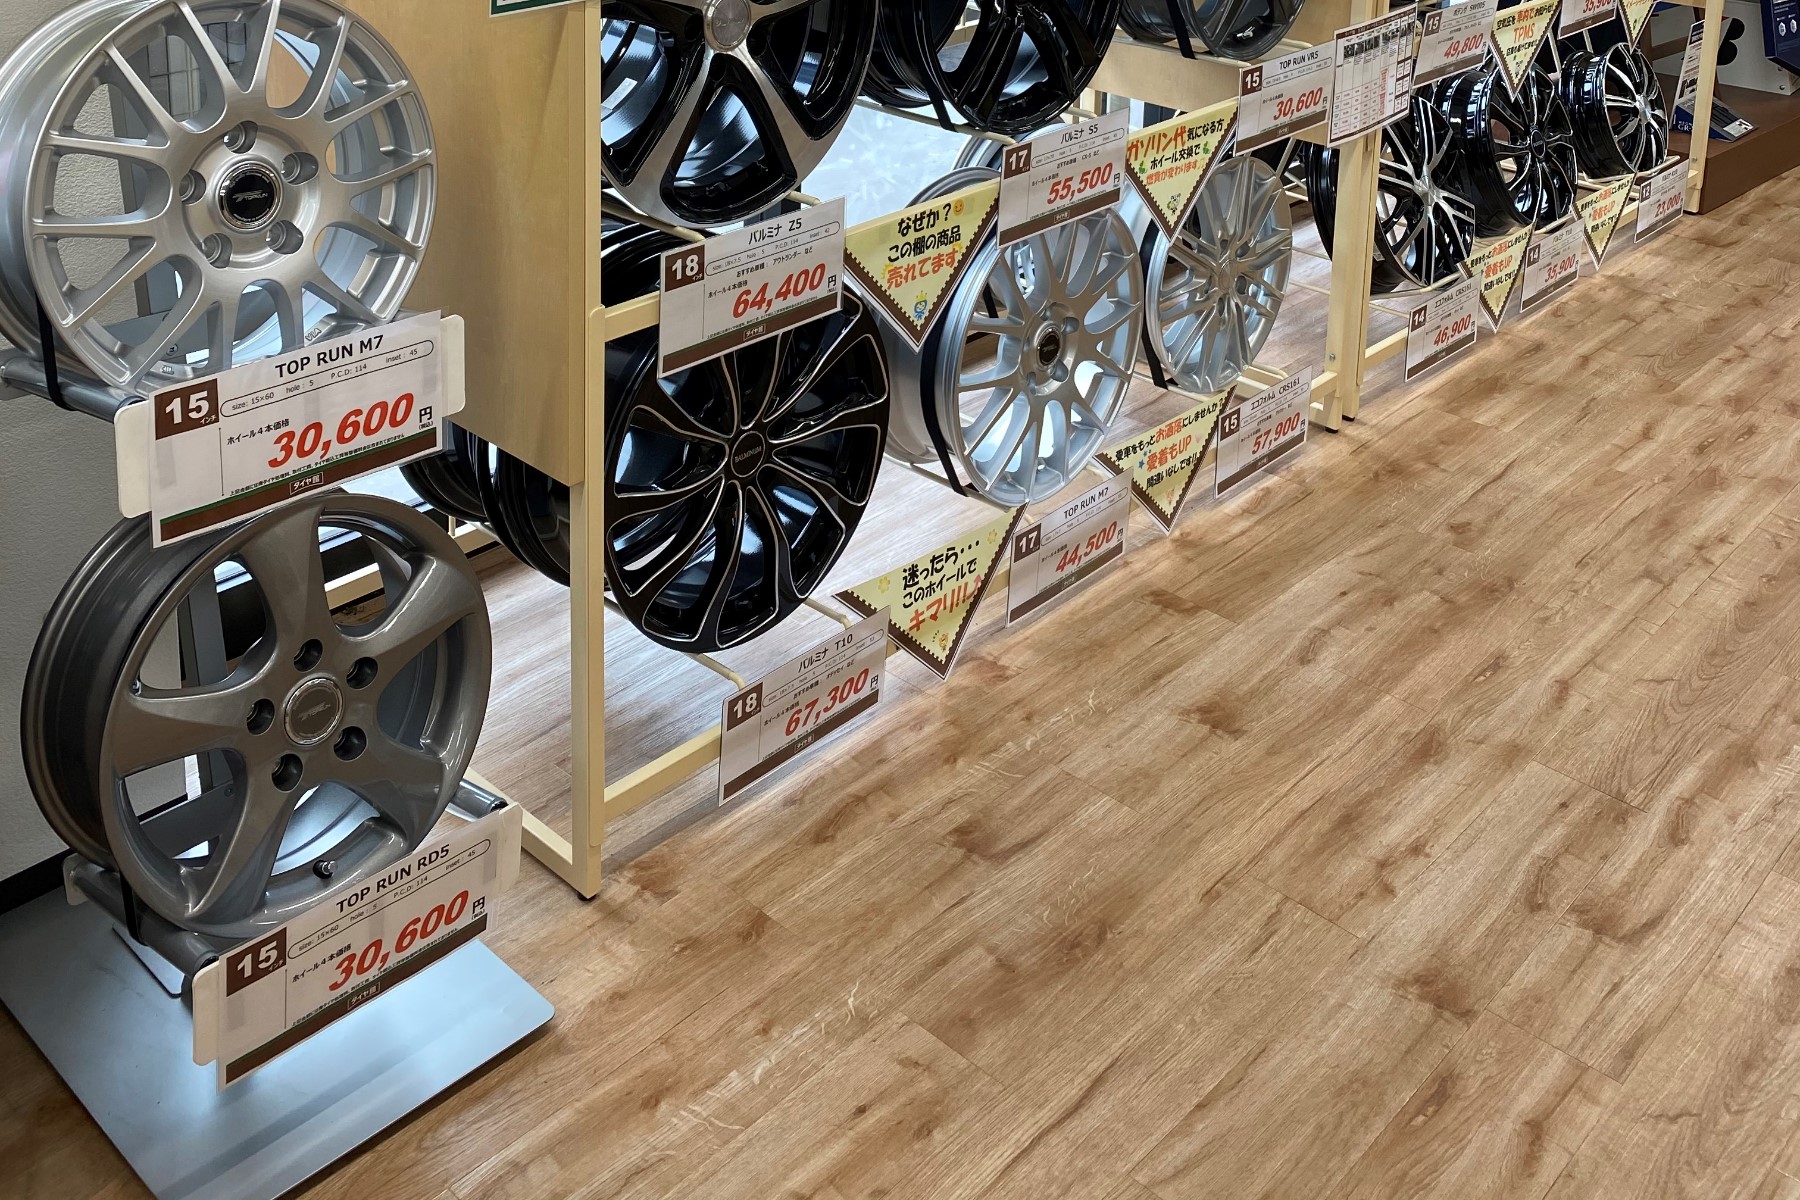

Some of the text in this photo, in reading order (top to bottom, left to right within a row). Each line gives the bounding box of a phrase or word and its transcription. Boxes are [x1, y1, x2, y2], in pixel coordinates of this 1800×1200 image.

[1428, 16, 1439, 31] 15
[1513, 23, 1536, 44] TPMS
[1444, 32, 1484, 59] 49,800
[1245, 71, 1260, 89] 15
[1280, 60, 1291, 70] TOP
[1274, 87, 1323, 120] 30,600
[1060, 123, 1099, 145] バルミナ S5
[1009, 149, 1028, 171] 17
[1150, 143, 1201, 170] ホイール交換で
[1047, 162, 1113, 205] 55,500
[1653, 191, 1682, 219] 23,000
[749, 217, 802, 245] バルミナ Z5
[888, 224, 961, 263] この棚の商品
[671, 254, 699, 280] 18
[886, 248, 959, 290] 売れてます
[1529, 249, 1540, 263] 14
[1544, 253, 1577, 284] 35,900
[732, 263, 837, 319] 64,400 円
[1413, 312, 1425, 327] 14
[1433, 313, 1472, 347] 46,900
[275, 335, 384, 379] TOP RUN M7
[164, 390, 210, 424] 15
[1223, 414, 1238, 433] 15
[267, 392, 433, 469] 30,600 円
[1251, 411, 1301, 455] 57,900
[1019, 487, 1109, 553] 17 TOP RUN M7
[1055, 520, 1118, 573] 44,500
[902, 557, 977, 609] このホイールで
[733, 633, 853, 719] 18 バルミナ T10
[785, 667, 870, 737] 67,300
[336, 844, 451, 913] TOP RUN RD5
[327, 889, 486, 992] 30,600 円
[236, 944, 278, 978] 15
